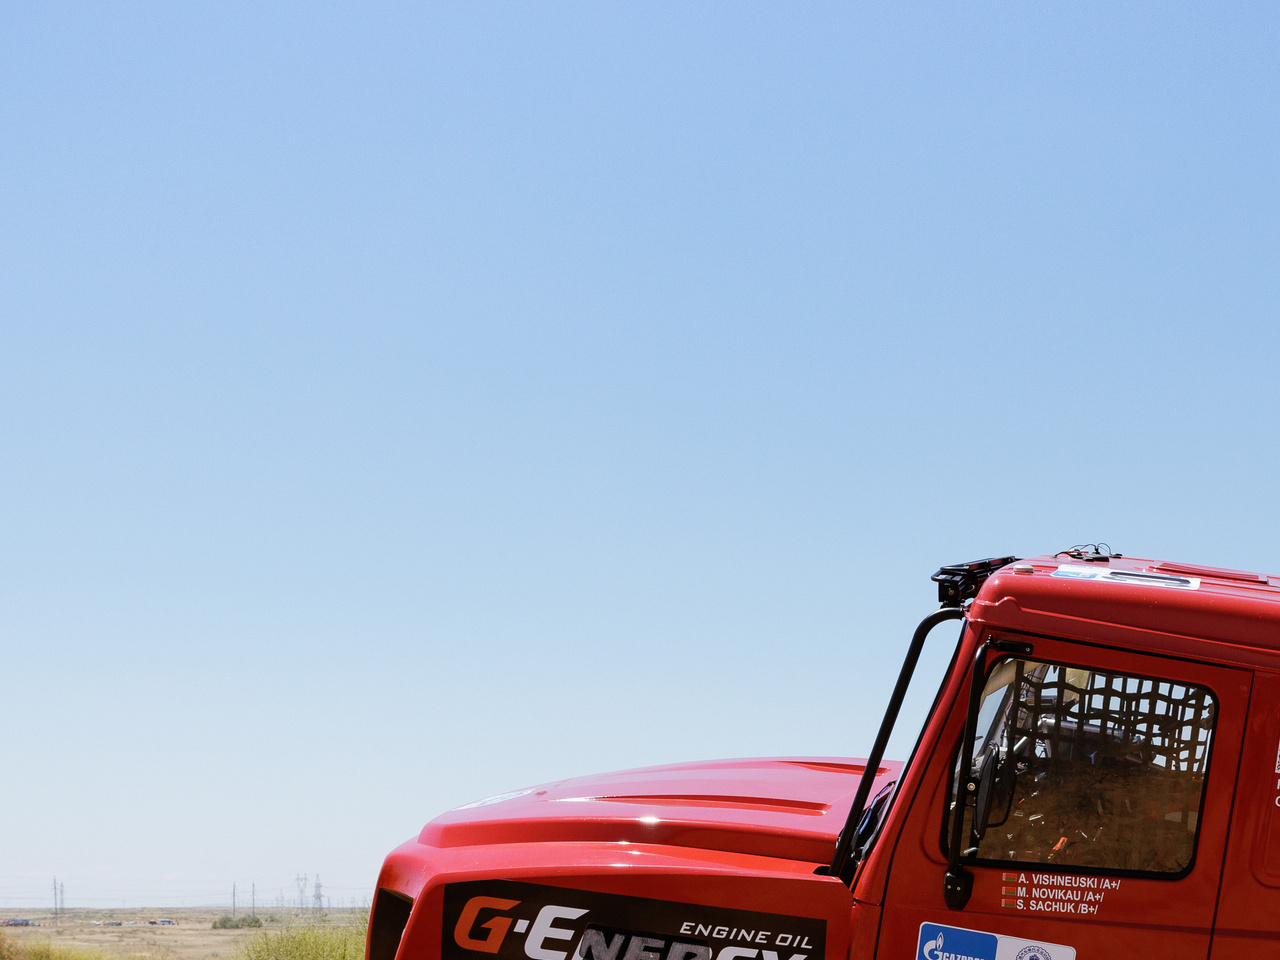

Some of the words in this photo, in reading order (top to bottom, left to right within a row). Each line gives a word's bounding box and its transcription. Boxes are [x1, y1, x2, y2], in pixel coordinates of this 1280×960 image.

[1018, 873, 1029, 884] A.
[1032, 874, 1098, 888] VISHNEUSKI
[1100, 878, 1121, 890] /A+/
[1017, 887, 1029, 898] M.
[1032, 888, 1081, 901] NOVIKAU
[1083, 891, 1104, 902] /A+/
[1016, 900, 1026, 910] S.
[1030, 900, 1076, 914] SACHUK
[1077, 904, 1098, 915] /B+/
[680, 922, 770, 944] ENGINE
[775, 934, 813, 949] OIL
